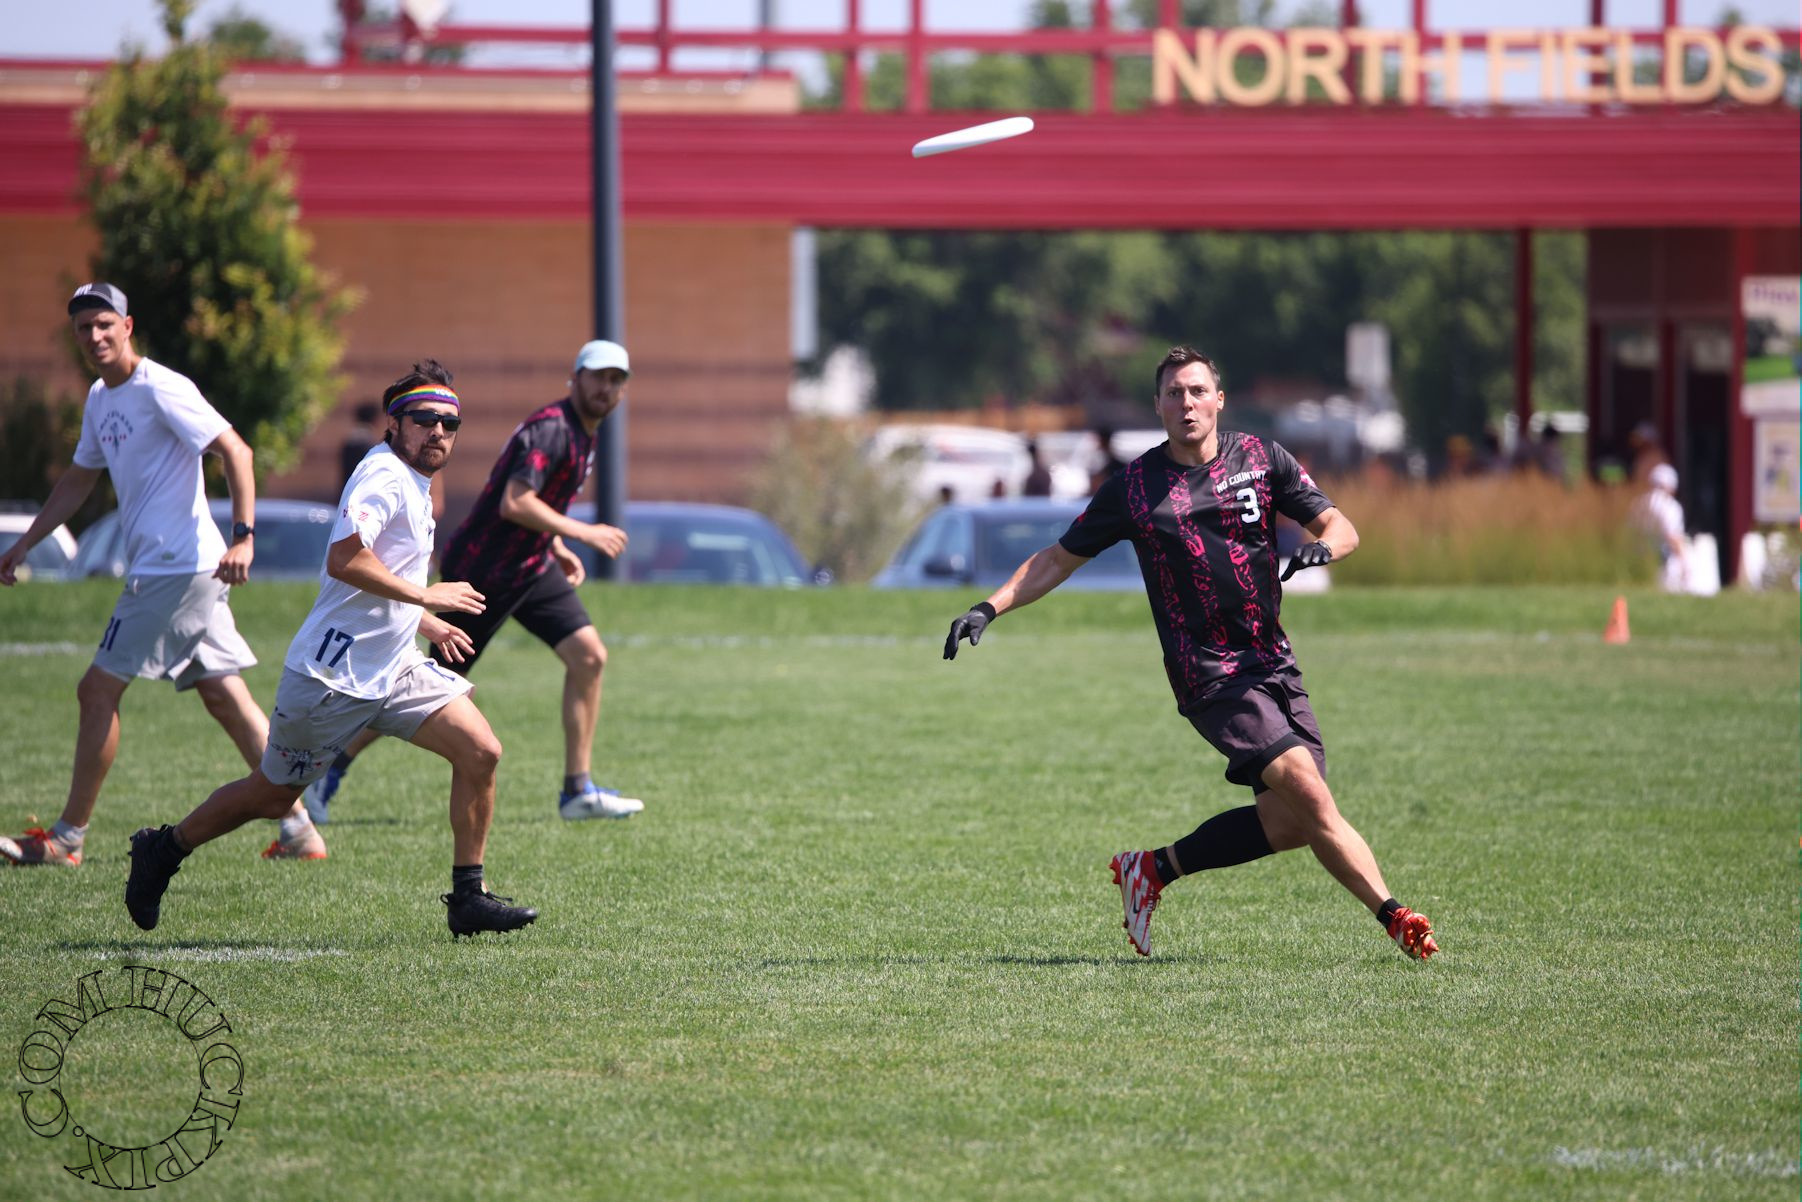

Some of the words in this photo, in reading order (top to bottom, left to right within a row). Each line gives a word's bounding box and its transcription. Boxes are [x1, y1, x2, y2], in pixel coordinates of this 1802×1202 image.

[1152, 28, 1464, 106] NORTH
[1488, 26, 1785, 106] FIELDS
[1216, 482, 1228, 493] NO
[1229, 470, 1266, 485] COUNTRY
[1236, 487, 1260, 523] 3
[315, 627, 354, 668] 17
